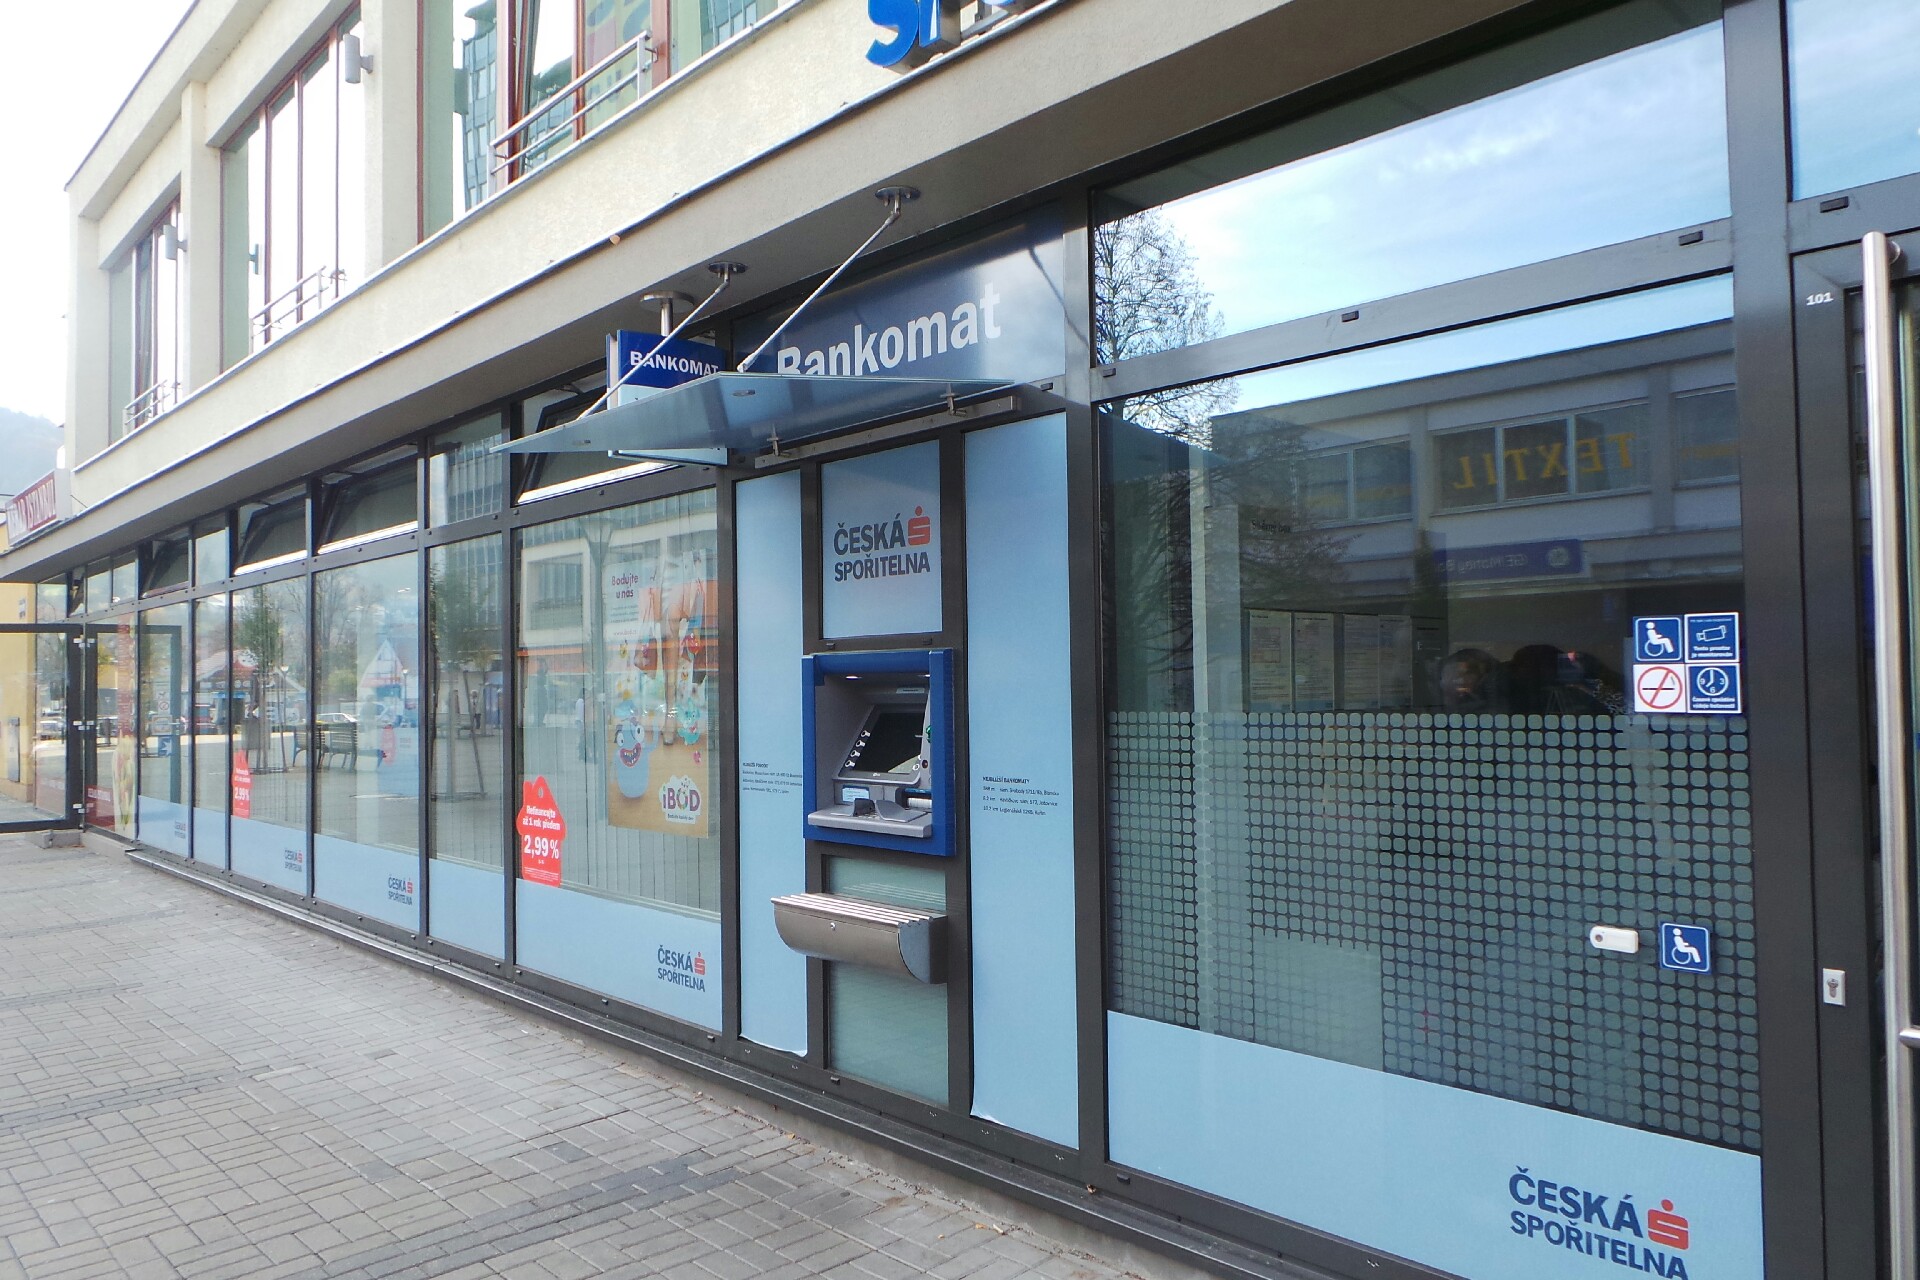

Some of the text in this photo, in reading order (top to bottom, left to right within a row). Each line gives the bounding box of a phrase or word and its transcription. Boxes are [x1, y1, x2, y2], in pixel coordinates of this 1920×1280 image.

[1806, 292, 1834, 306] 101
[778, 282, 1001, 376] Bankomat
[630, 351, 719, 376] BANKOMAT
[833, 512, 906, 556] ČESKÁ
[611, 573, 639, 587] Bodujte
[834, 552, 931, 582] SPOŘITELNA
[621, 587, 634, 599] nás
[657, 944, 694, 973] ČESKÁ
[657, 967, 706, 993] SPOŘITELNA
[1508, 1165, 1644, 1239] ČESKÁ
[1509, 1210, 1689, 1280] SPOŘITELNA
